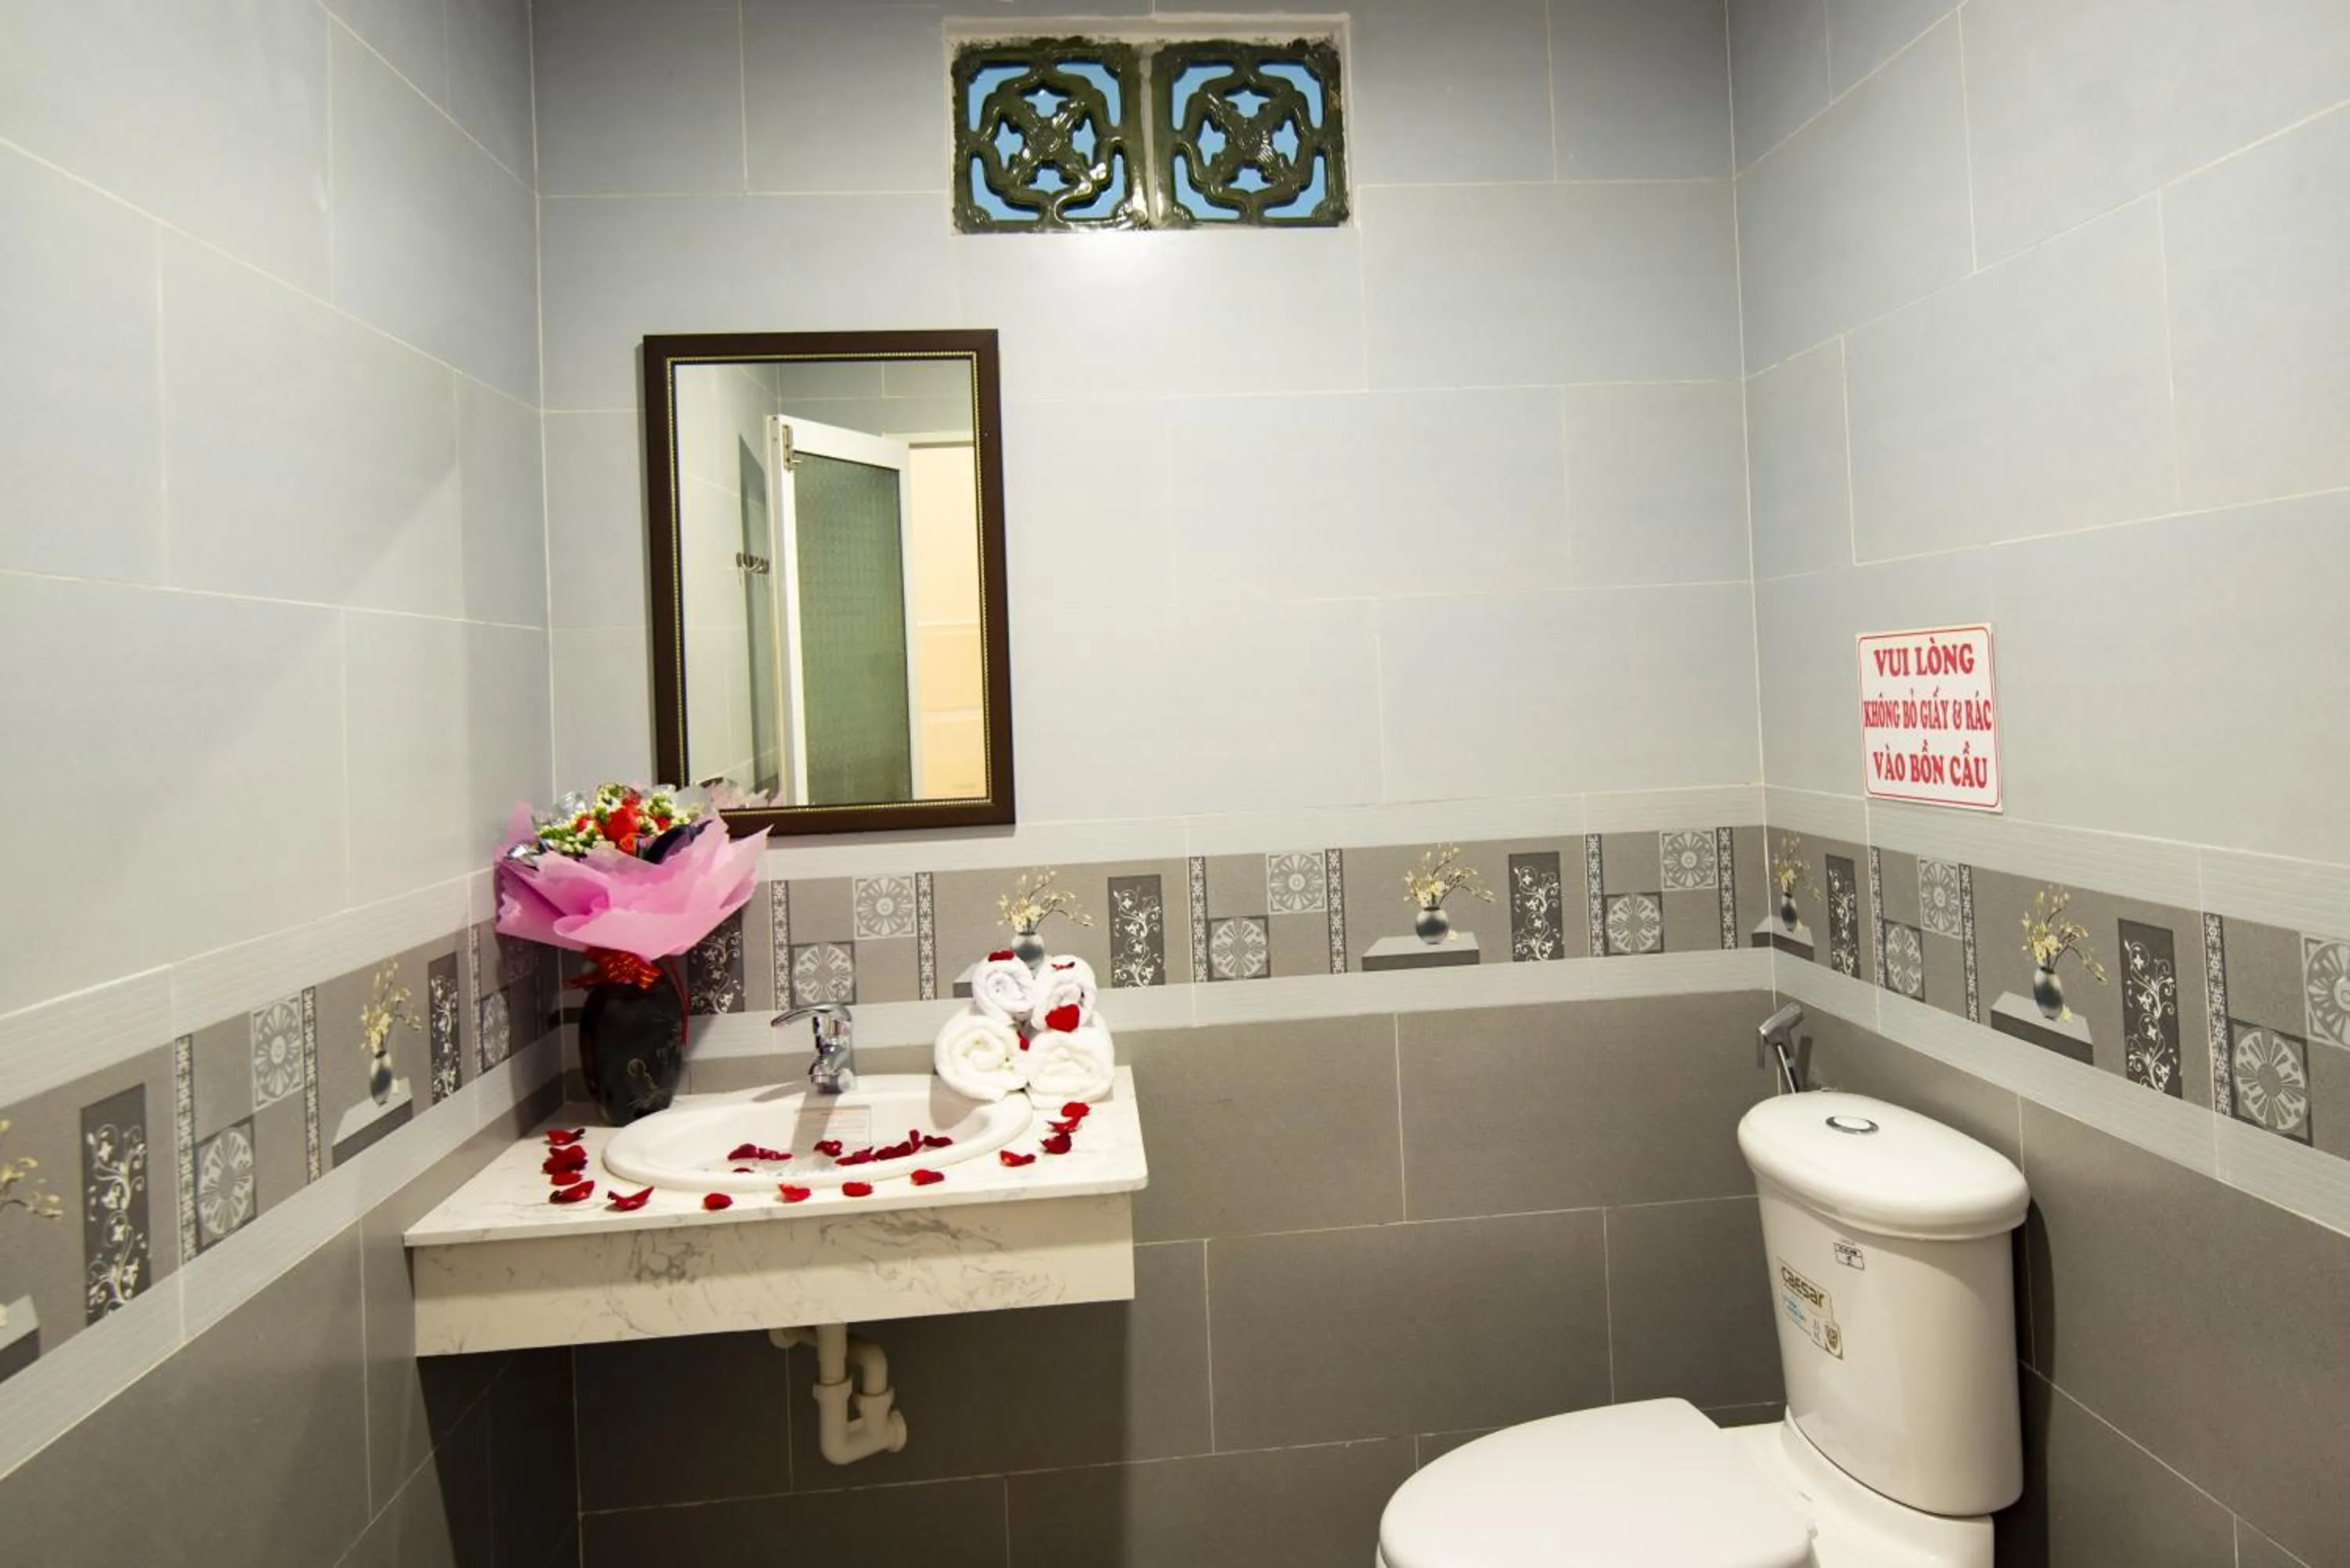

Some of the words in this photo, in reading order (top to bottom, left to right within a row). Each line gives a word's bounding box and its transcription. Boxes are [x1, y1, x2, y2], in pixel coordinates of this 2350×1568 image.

[1873, 648, 1911, 677] VUI
[1914, 637, 1975, 676] LÒNG
[1863, 692, 1900, 729] KHÔNG
[1902, 688, 1918, 730] BỎ
[1920, 685, 1949, 730] GIẤY
[1965, 690, 1992, 731] RÁC
[1873, 743, 1906, 782] VÀO
[1909, 739, 1944, 785] BỒN
[1950, 740, 1988, 789] CẦU
